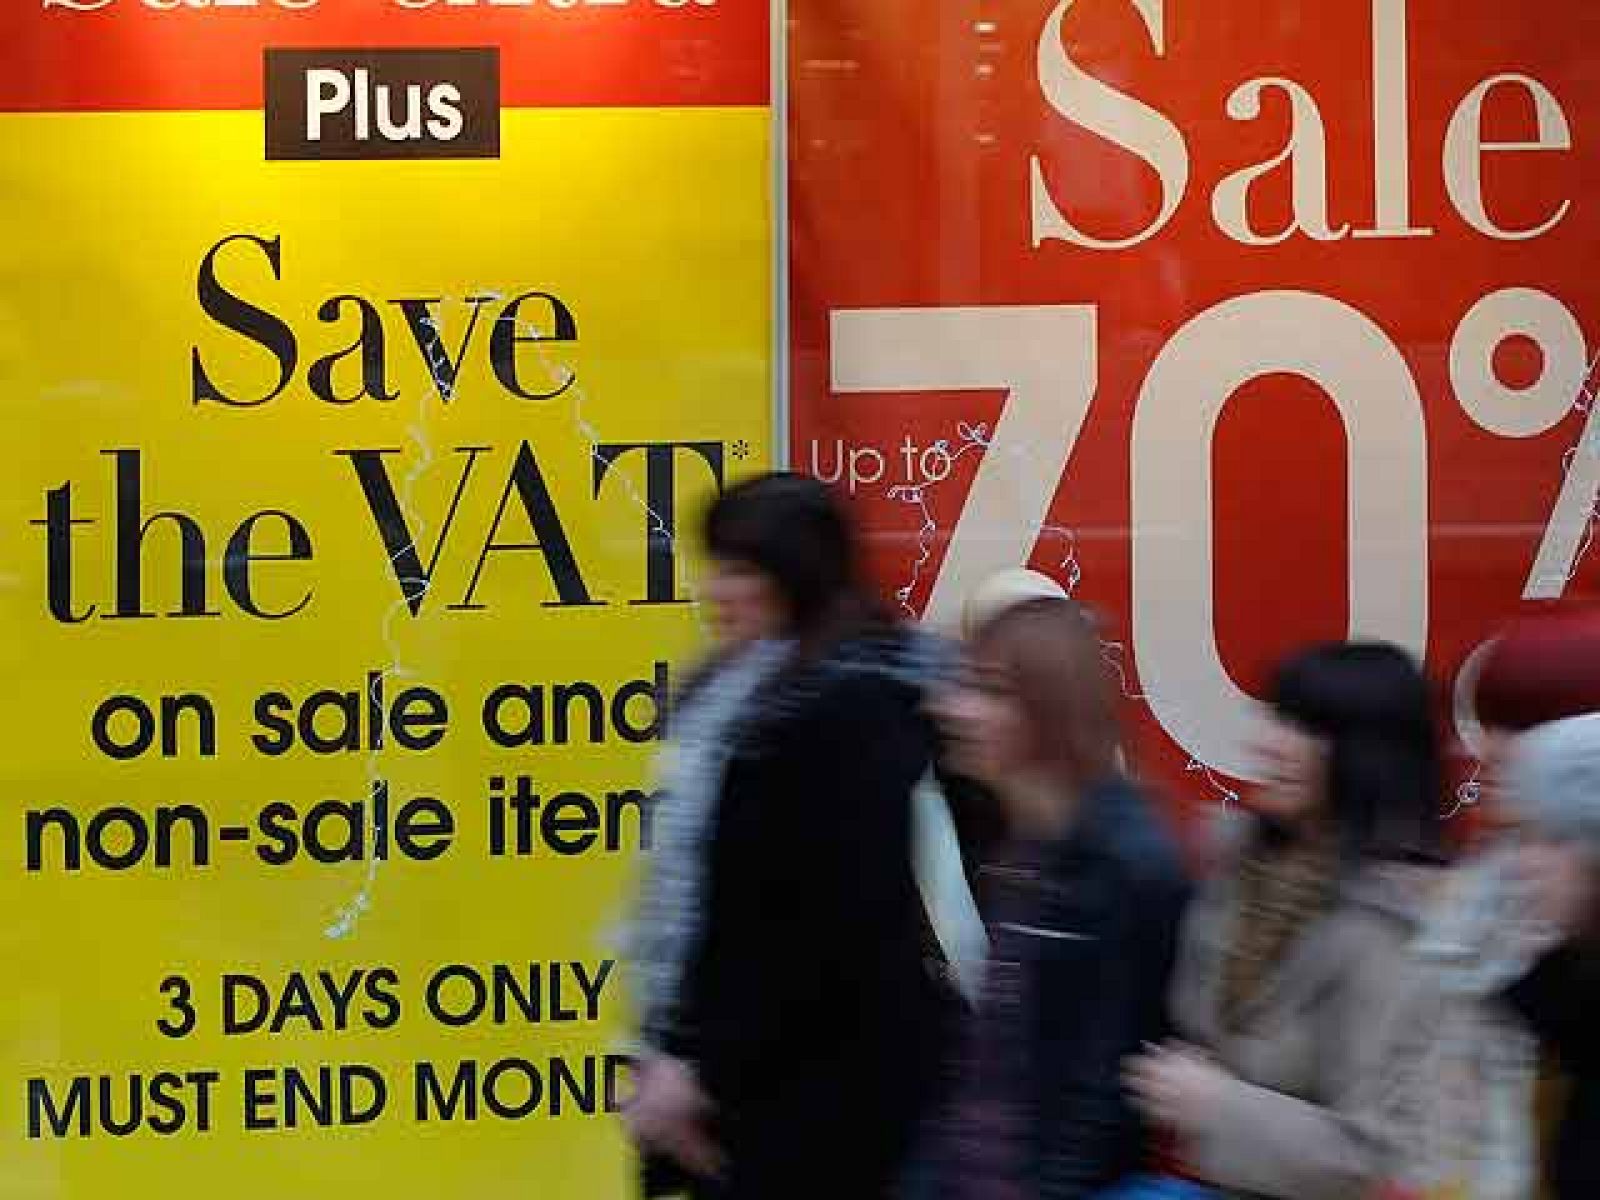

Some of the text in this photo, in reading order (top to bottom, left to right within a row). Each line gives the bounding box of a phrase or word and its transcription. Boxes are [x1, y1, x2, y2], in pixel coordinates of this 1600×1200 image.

[306, 69, 464, 141] Plus
[1030, 0, 1572, 249] Sale
[191, 234, 578, 406] Save
[811, 434, 951, 495] Up to
[29, 449, 314, 623] the
[91, 661, 668, 760] on sale and
[24, 780, 454, 872] non-sale
[156, 960, 616, 1038] 3 DAYS ONLY
[26, 1070, 220, 1139] MUST
[243, 1063, 388, 1130] END
